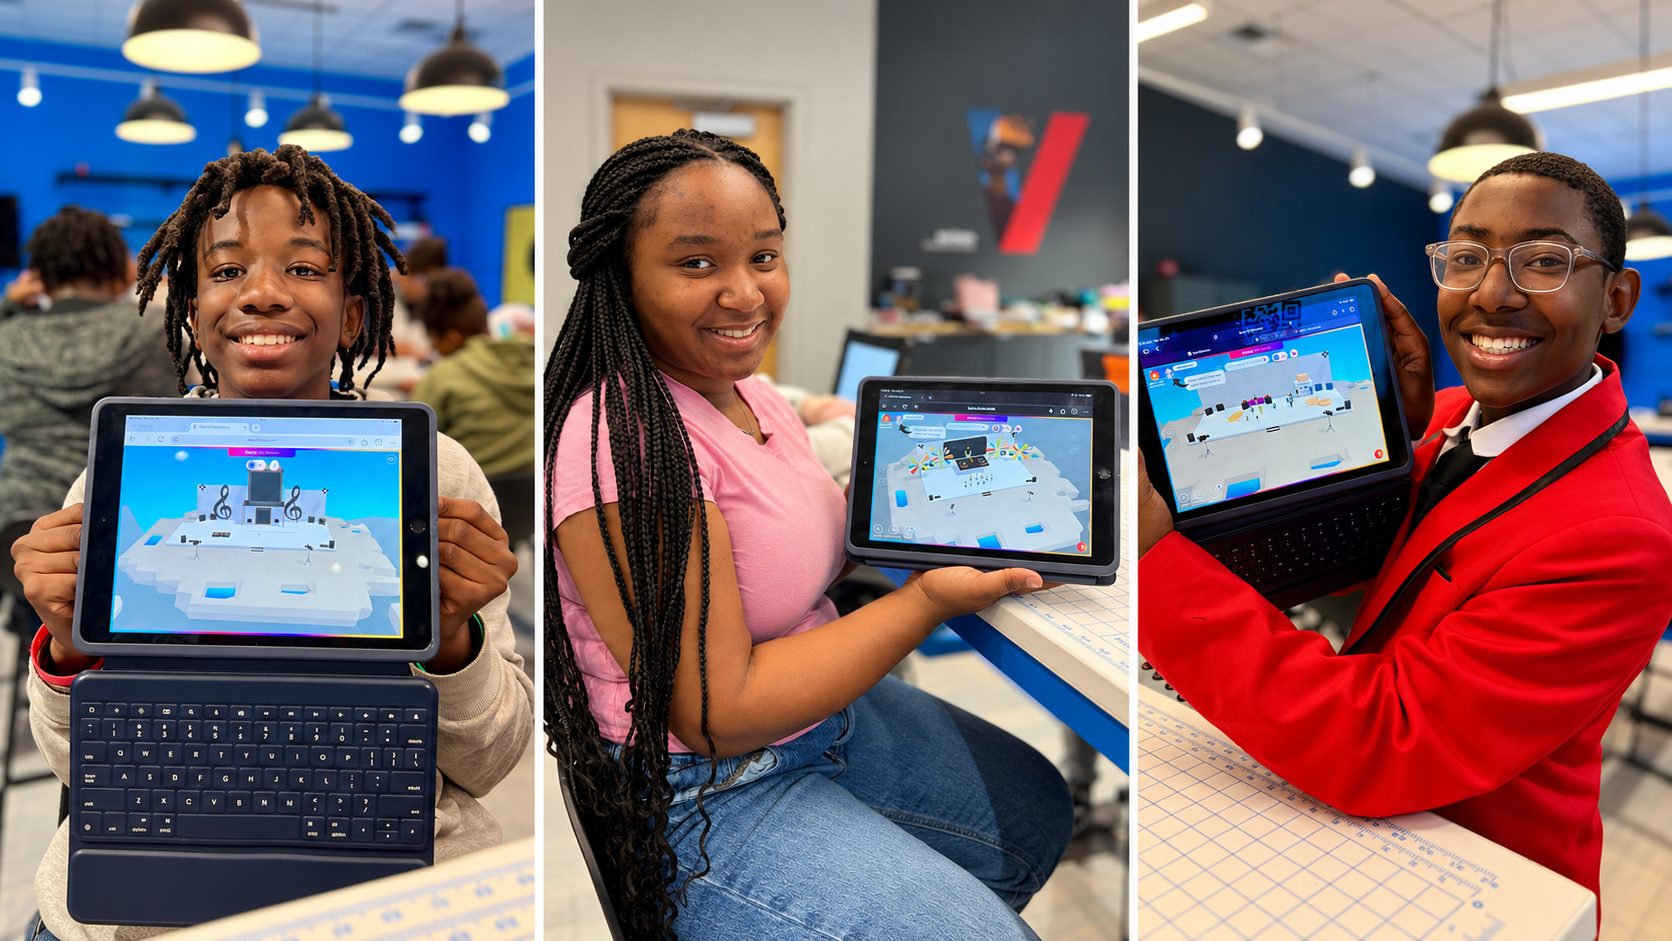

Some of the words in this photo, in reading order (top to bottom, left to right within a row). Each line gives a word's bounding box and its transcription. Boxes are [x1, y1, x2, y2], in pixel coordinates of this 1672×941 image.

[137, 730, 142, 738] 2
[162, 730, 167, 738] 3
[288, 733, 294, 741] 8
[117, 749, 124, 757] Q
[168, 750, 173, 758] E
[319, 753, 327, 761] O
[147, 773, 153, 781] S
[198, 774, 203, 782] F
[222, 775, 229, 783] G
[324, 777, 329, 785] L
[236, 799, 242, 807] B
